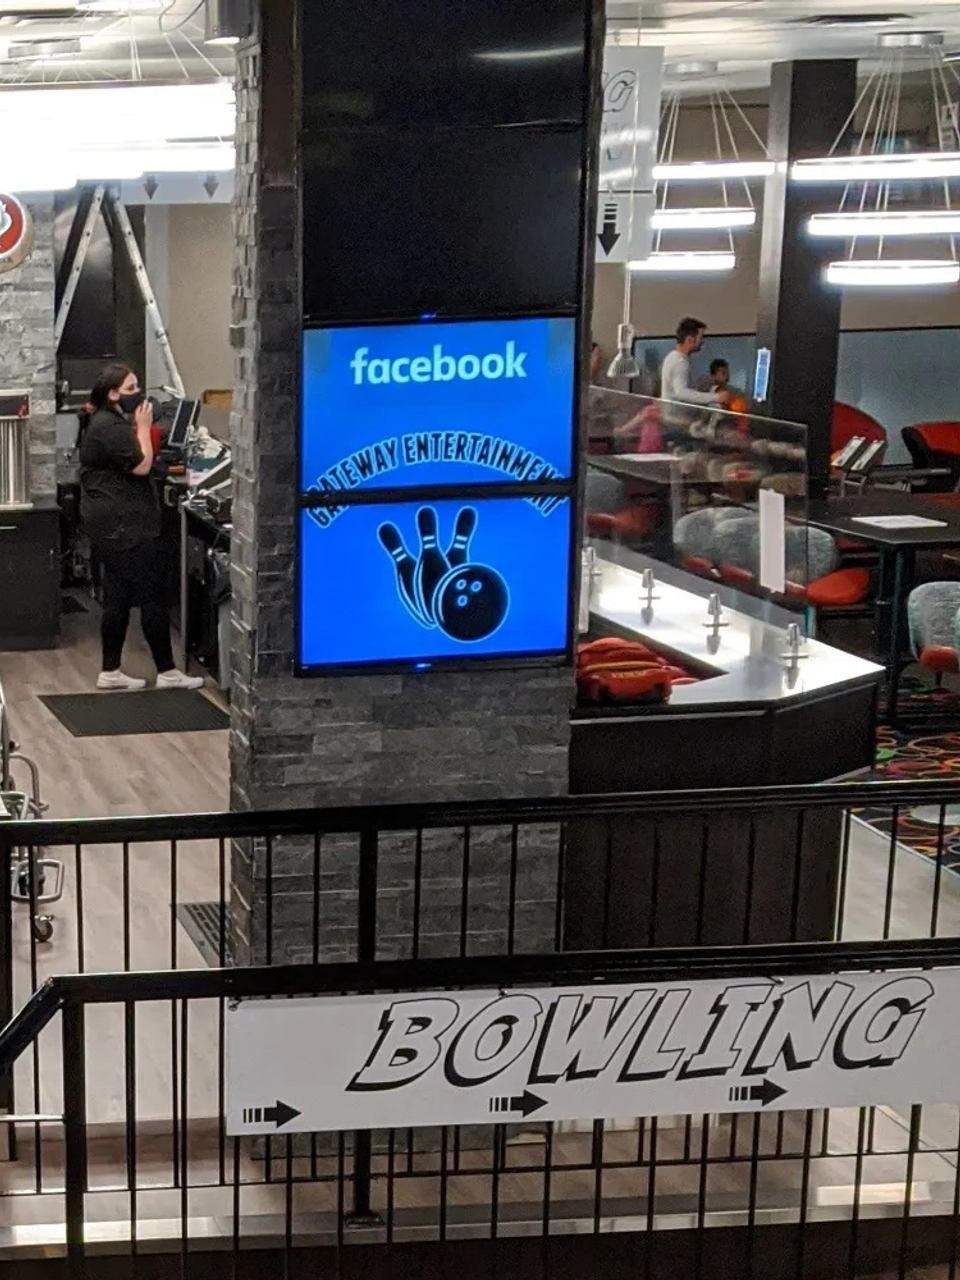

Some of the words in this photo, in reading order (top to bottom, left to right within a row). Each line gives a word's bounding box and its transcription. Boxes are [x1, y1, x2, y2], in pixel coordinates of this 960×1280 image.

[350, 340, 528, 385] facebook
[305, 437, 398, 529] GATEWAY
[345, 977, 935, 1092] BOWLING
